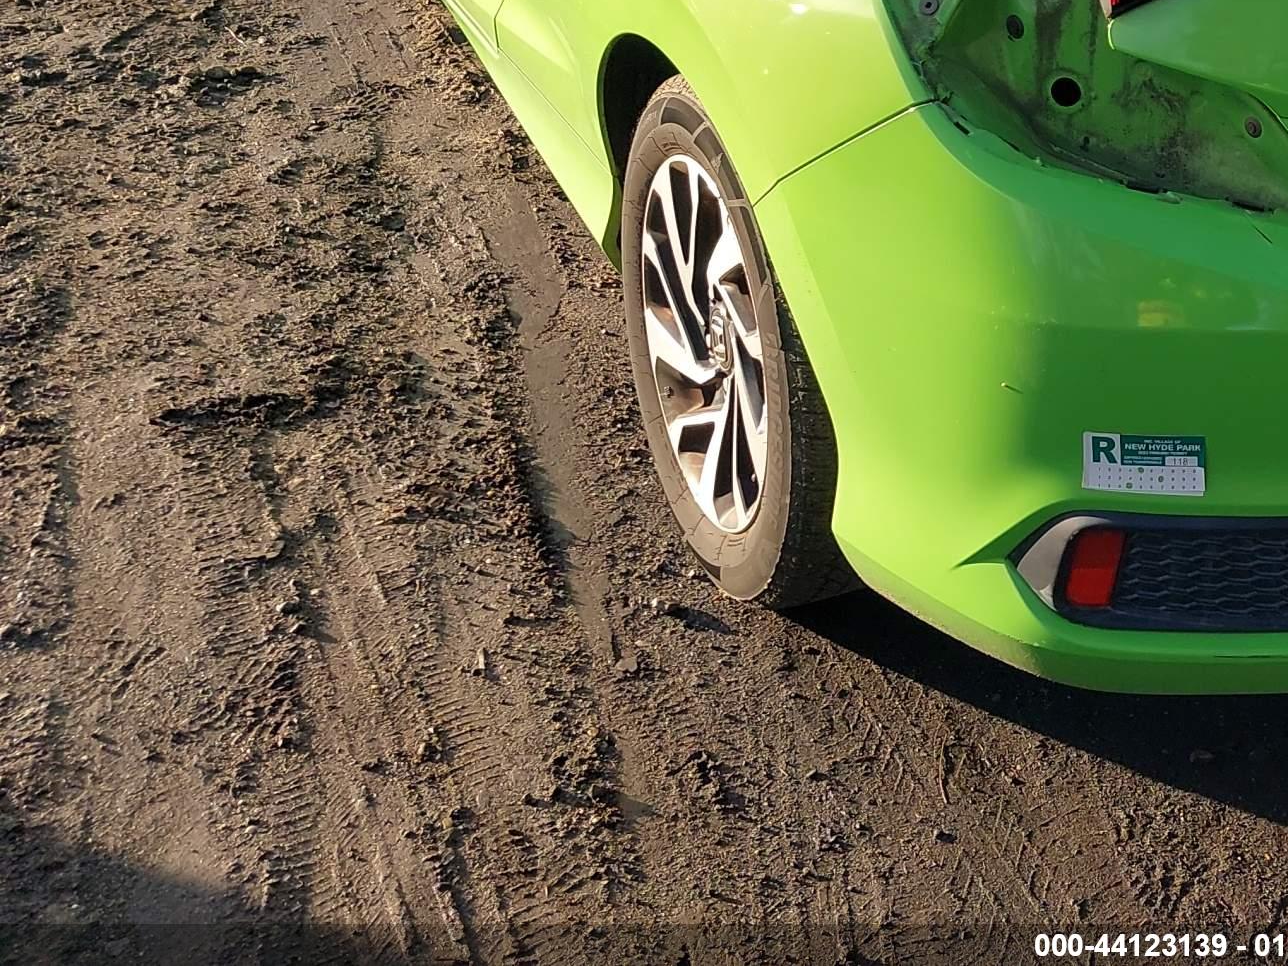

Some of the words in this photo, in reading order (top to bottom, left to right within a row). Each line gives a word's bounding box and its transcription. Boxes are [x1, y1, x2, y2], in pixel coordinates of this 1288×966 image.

[1091, 436, 1118, 464] R
[1124, 443, 1147, 451] NEW
[1176, 444, 1201, 452] PARK
